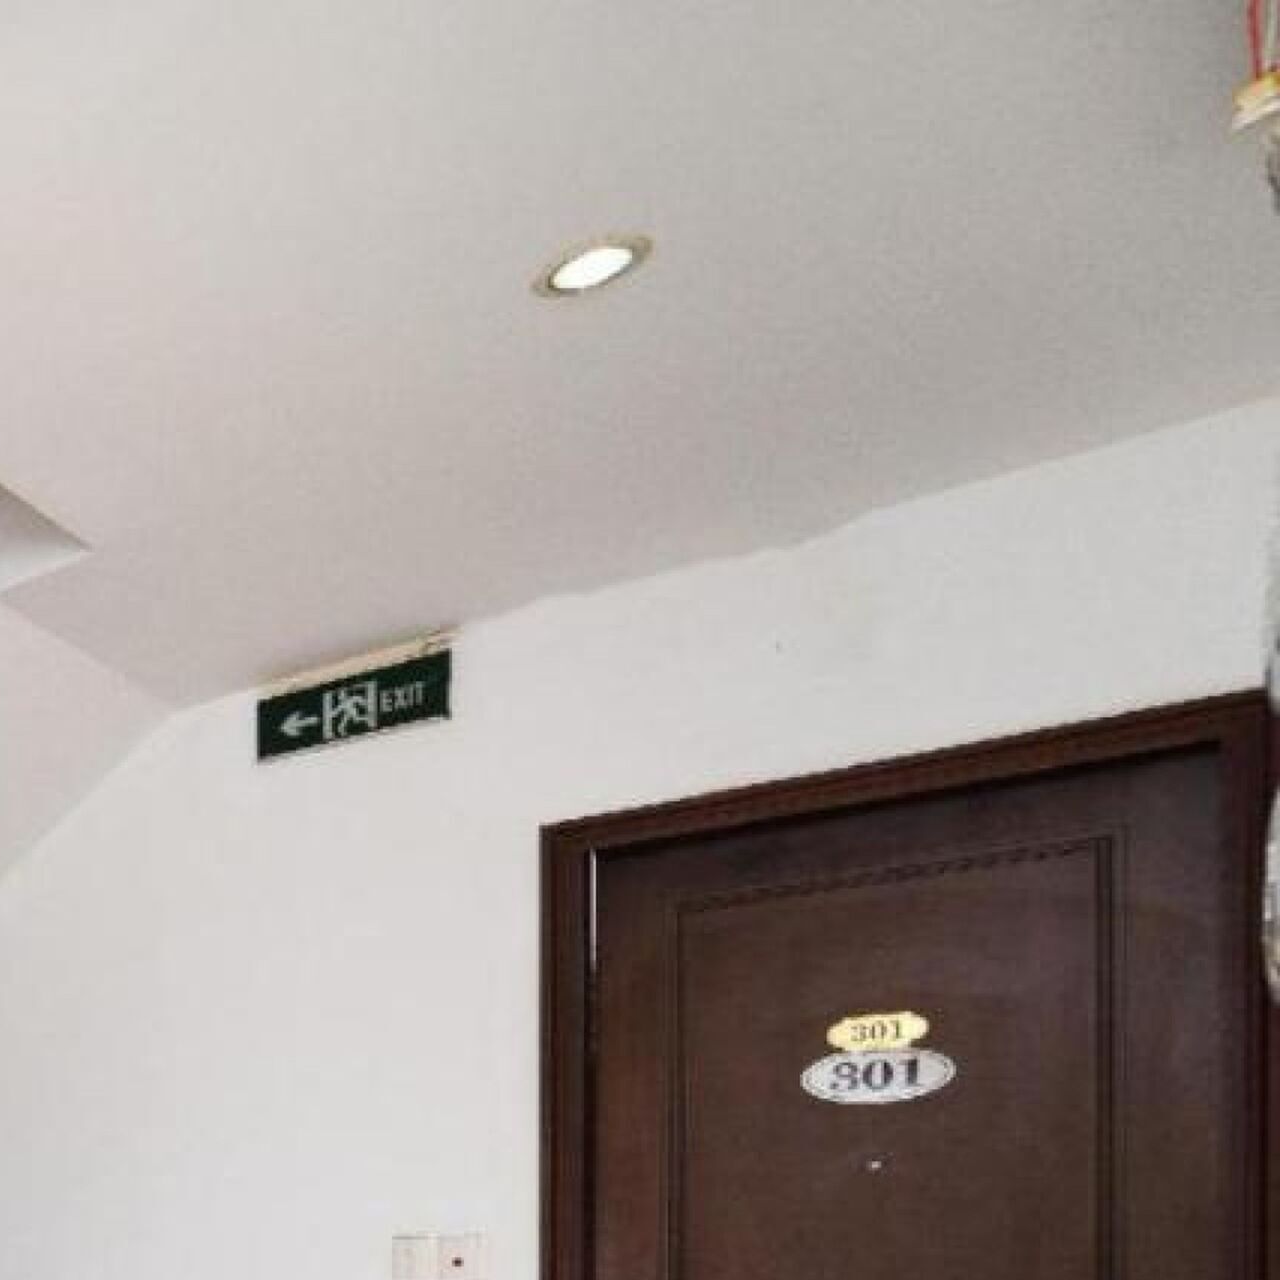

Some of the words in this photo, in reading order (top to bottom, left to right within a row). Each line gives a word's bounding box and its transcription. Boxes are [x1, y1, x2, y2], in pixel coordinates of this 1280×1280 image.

[380, 681, 425, 713] EXIT
[850, 1019, 905, 1043] 301
[830, 1057, 921, 1092] 301
